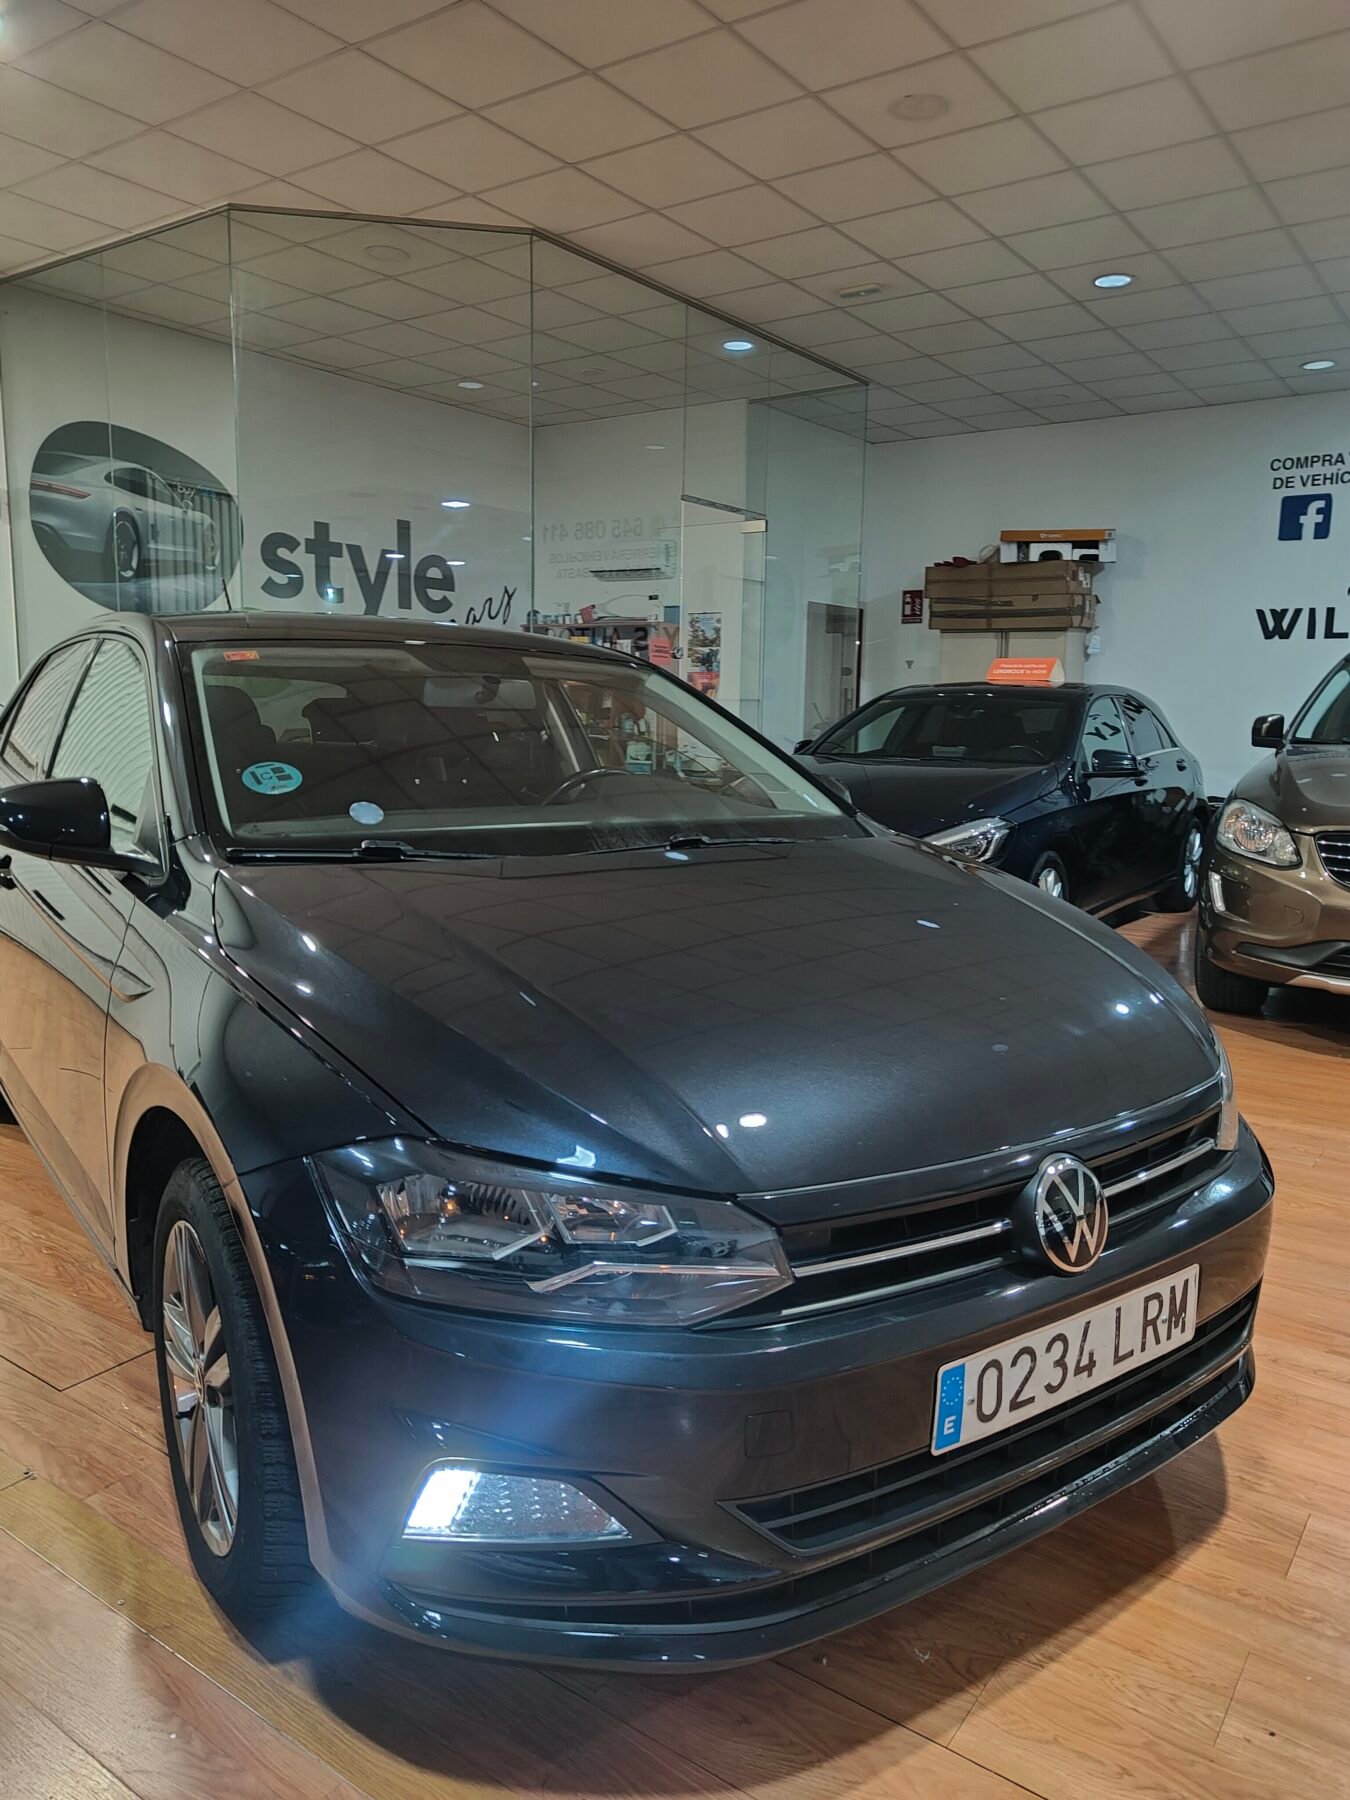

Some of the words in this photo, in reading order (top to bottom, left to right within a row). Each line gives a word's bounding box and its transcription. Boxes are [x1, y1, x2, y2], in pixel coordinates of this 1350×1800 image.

[1270, 453, 1346, 472] COMPRA
[1272, 476, 1296, 490] DE
[260, 519, 455, 615] style
[450, 585, 518, 625] ars
[1256, 606, 1349, 640] WIL
[976, 1320, 1097, 1423] 0234
[1113, 1278, 1190, 1366] LRM
[942, 1415, 957, 1435] E
